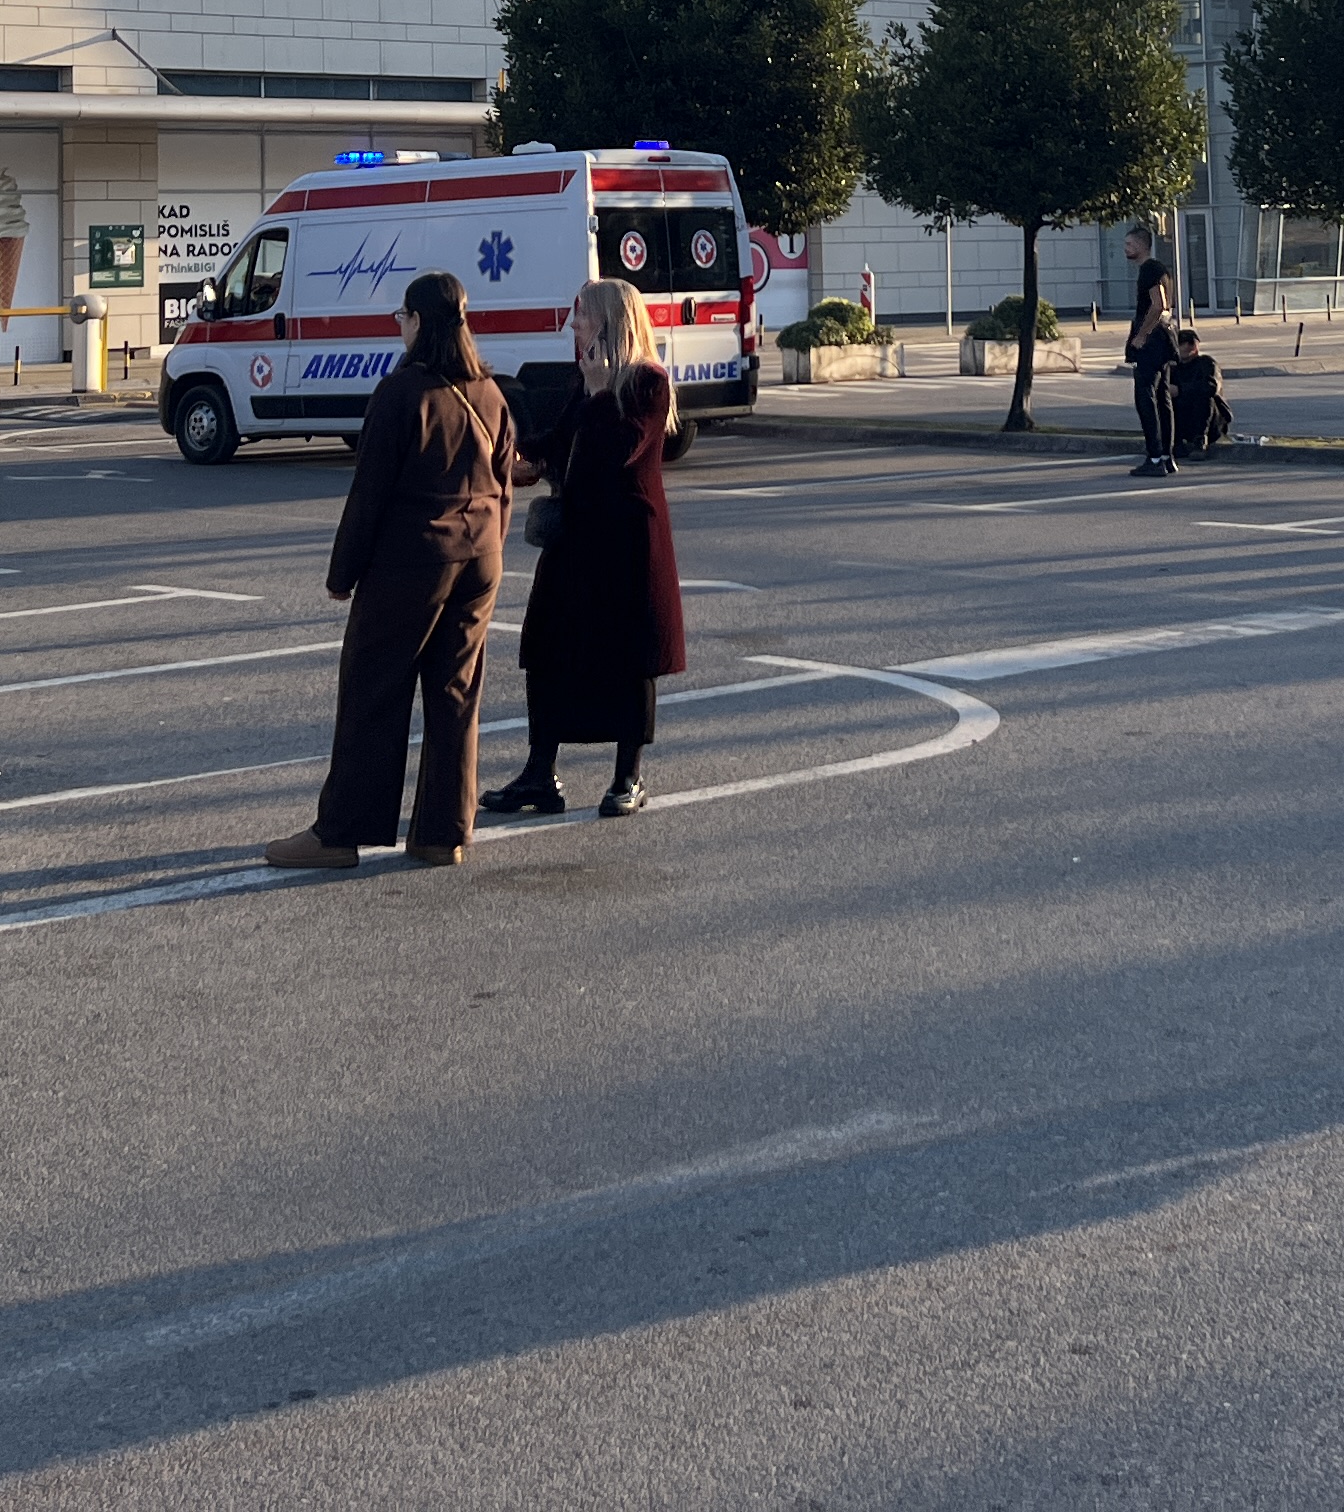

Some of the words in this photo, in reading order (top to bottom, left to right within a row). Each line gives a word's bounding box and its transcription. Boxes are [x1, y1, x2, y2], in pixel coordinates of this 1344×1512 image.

[158, 205, 190, 219] KAD
[158, 220, 230, 238] POMISLIŠ
[158, 244, 181, 258] NA
[186, 243, 239, 257] RADO
[301, 352, 399, 379] AMBUL
[667, 361, 738, 382] LANCE
